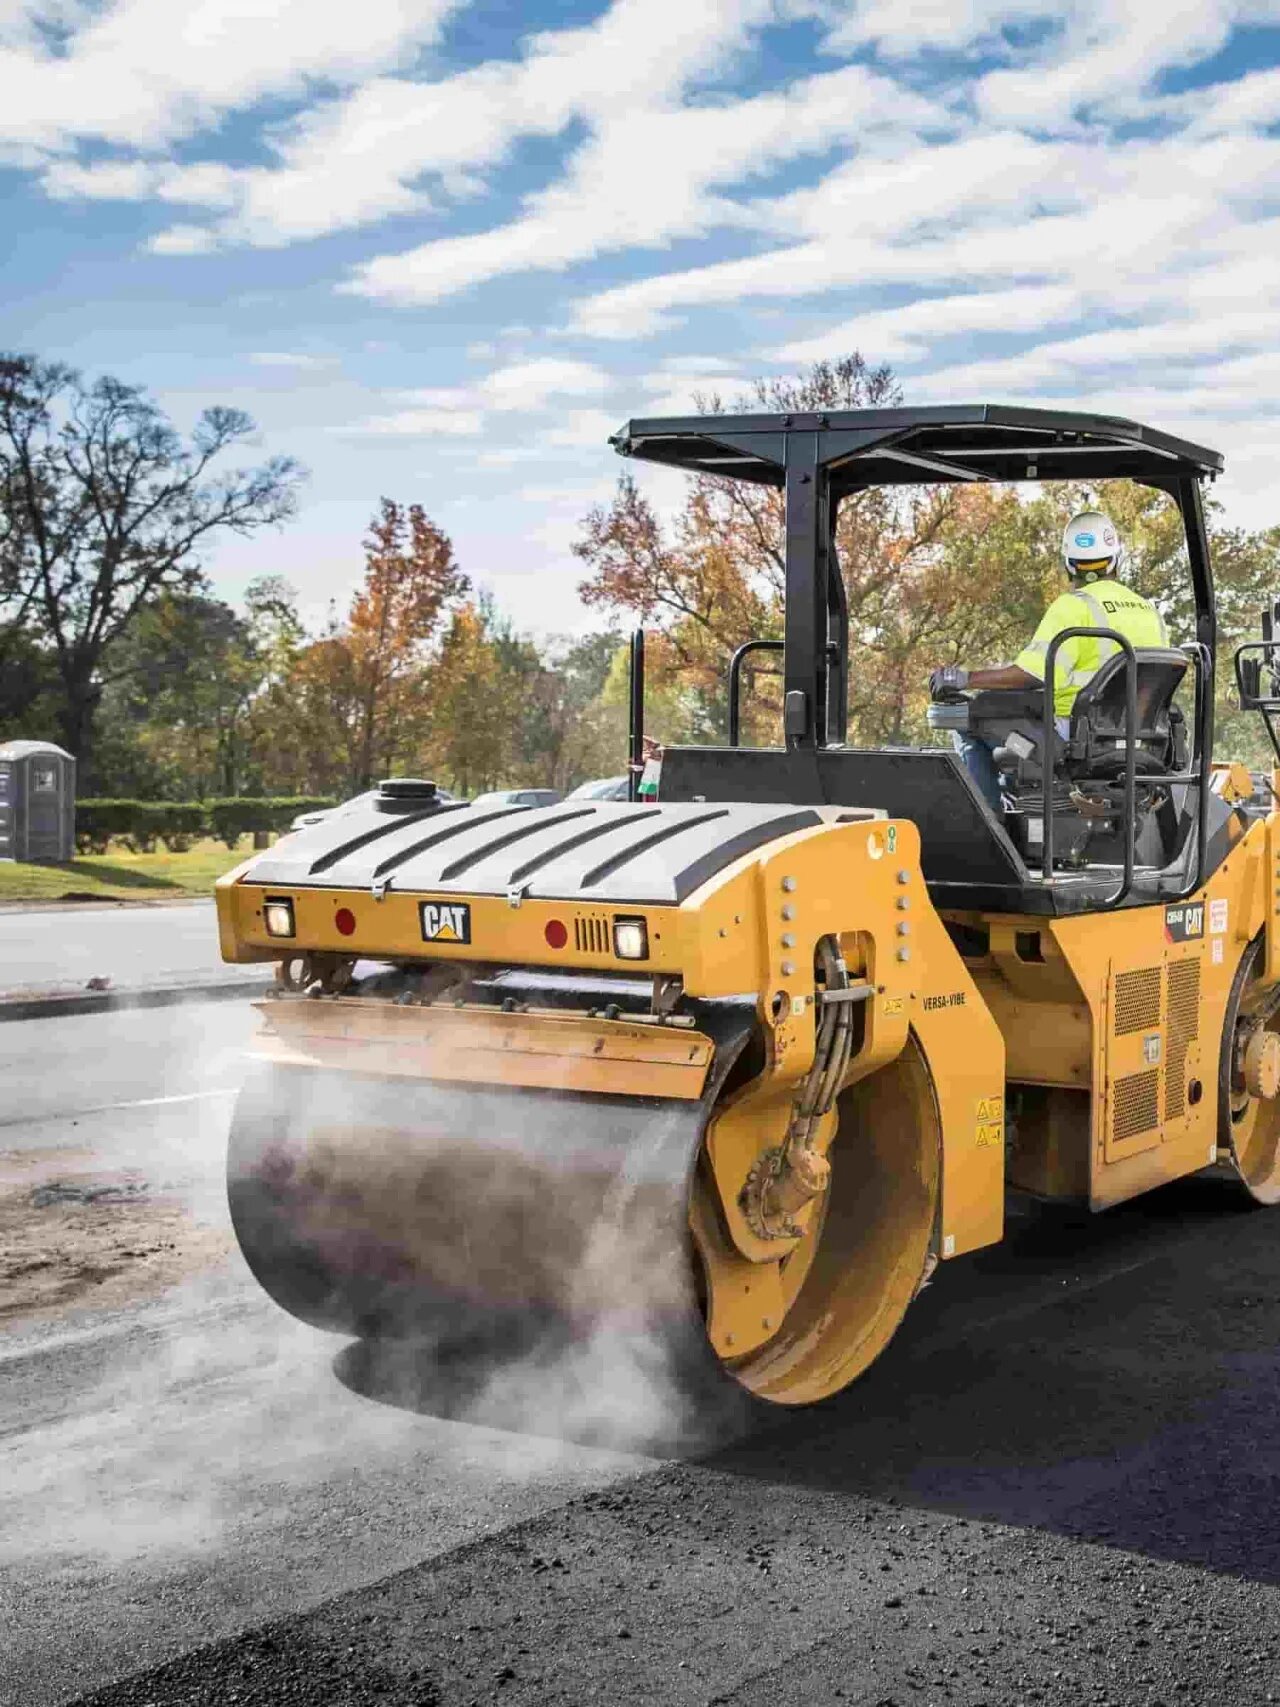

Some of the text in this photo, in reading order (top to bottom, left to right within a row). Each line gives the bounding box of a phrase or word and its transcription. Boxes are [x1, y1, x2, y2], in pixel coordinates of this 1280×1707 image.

[424, 905, 467, 940] CAT
[1185, 907, 1204, 936] CAT
[923, 991, 966, 1011] VERSA-VIBE
